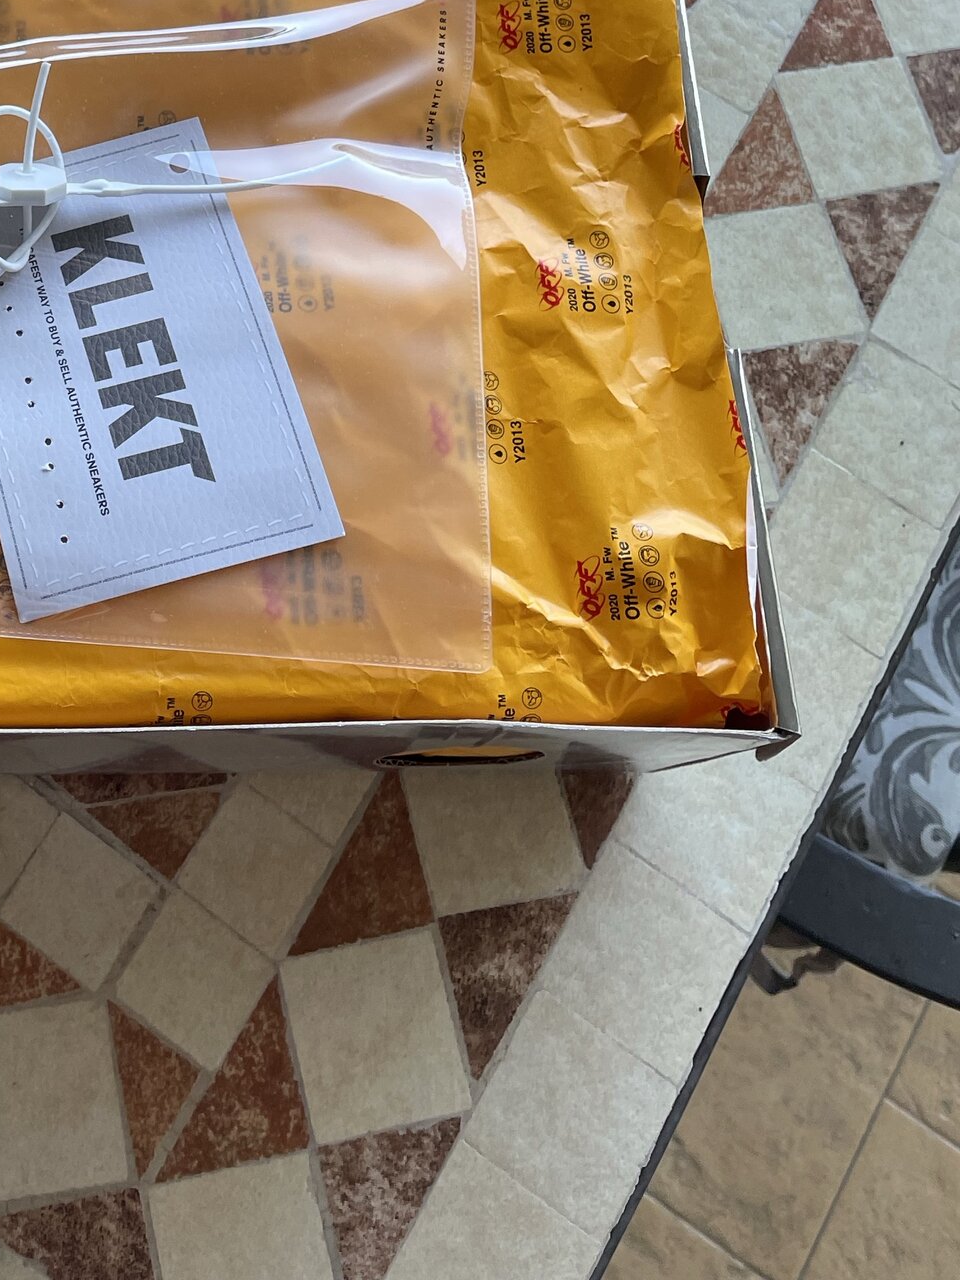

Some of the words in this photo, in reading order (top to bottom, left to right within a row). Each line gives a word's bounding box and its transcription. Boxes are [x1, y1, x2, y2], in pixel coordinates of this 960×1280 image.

[524, 10, 533, 20] M.
[525, 31, 536, 54] 2020
[580, 14, 593, 52] Y2013
[426, 78, 444, 151] AUTHENTIC
[437, 10, 447, 72] SNEAKERS
[472, 150, 487, 187] Y2013
[36, 284, 51, 308] WAY
[567, 288, 579, 312] 2020
[623, 275, 634, 314] Y2013
[43, 309, 55, 324] TO
[48, 325, 62, 347] BUY
[51, 214, 216, 482] KLEKT
[55, 349, 64, 358] &
[58, 358, 72, 385] SELL
[66, 387, 92, 451] AUTHENTIC
[510, 420, 526, 463] Y2013
[85, 452, 110, 517] SNEAKERS
[604, 568, 615, 581] M.
[669, 571, 679, 616] Y2013
[608, 594, 621, 621] 2020
